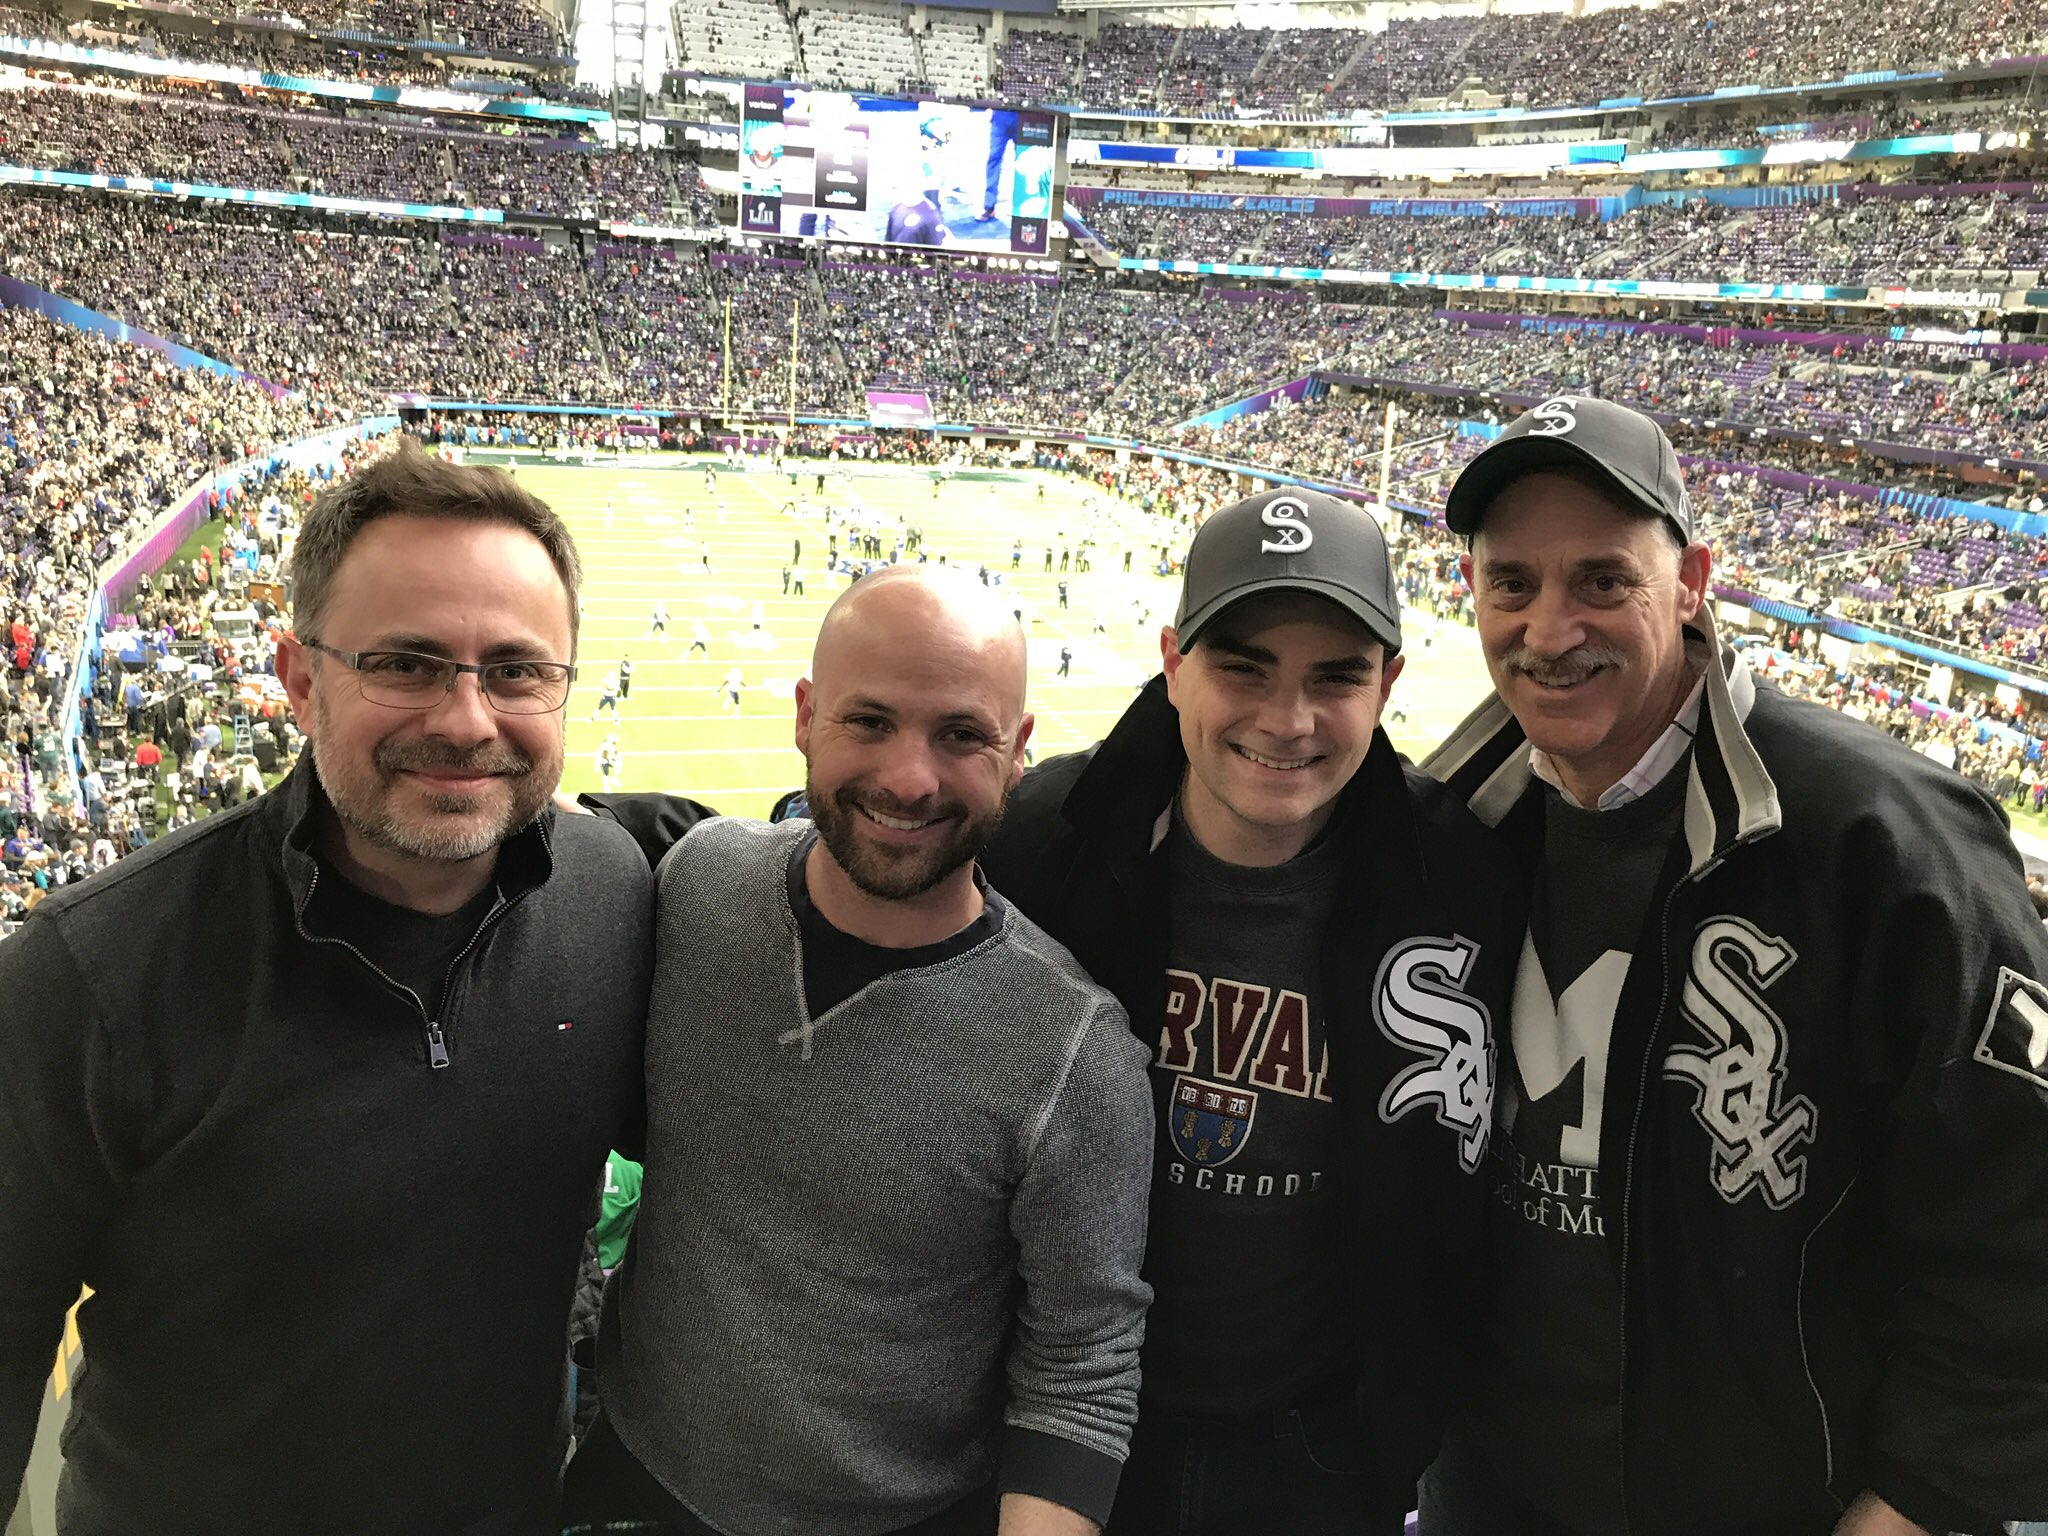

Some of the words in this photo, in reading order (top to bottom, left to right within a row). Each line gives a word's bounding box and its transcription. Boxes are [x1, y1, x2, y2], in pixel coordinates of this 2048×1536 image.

[308, 115, 342, 125] SERVICES
[343, 120, 373, 129] HOTLINE
[1103, 190, 1233, 210] PHILADELPHIA
[1245, 198, 1316, 214] EAGLES
[1369, 200, 1409, 216] NEW
[1410, 202, 1490, 218] ENGLAND
[1500, 201, 1577, 217] PATRIOTS
[1155, 967, 1334, 1103] RVA
[1523, 1196, 1553, 1227] of
